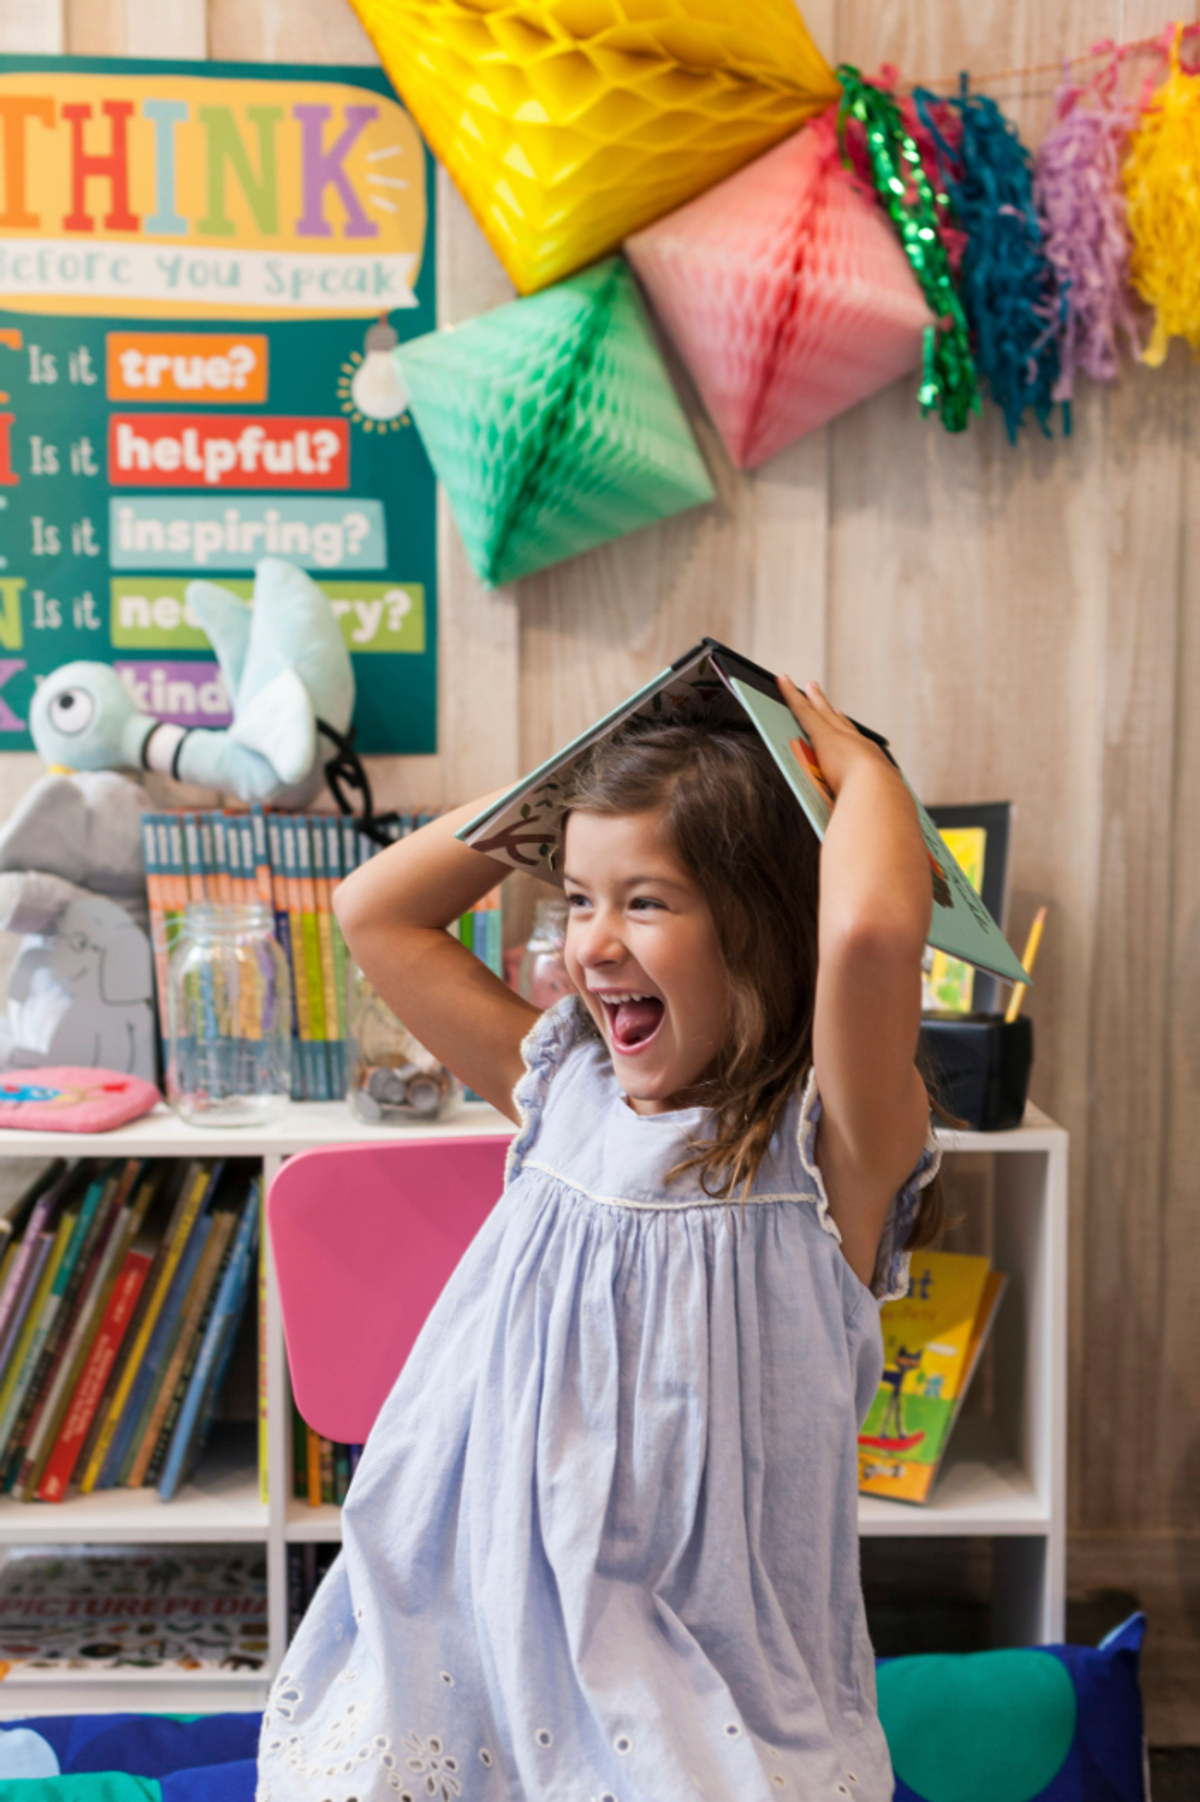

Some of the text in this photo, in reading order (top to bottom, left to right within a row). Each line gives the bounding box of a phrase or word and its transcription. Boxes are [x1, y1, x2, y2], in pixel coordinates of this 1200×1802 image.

[0, 95, 380, 238] THINK
[156, 253, 240, 288] You
[264, 259, 397, 301] Speak
[28, 344, 58, 385] Is
[68, 345, 97, 386] it
[118, 345, 256, 390] true?
[29, 435, 60, 476] Is
[70, 436, 99, 477] it
[116, 424, 341, 484] helpful?
[31, 516, 61, 556] Is
[71, 517, 100, 557] it
[117, 507, 370, 567] inspiring?
[32, 589, 62, 629] Is
[73, 590, 101, 630] it
